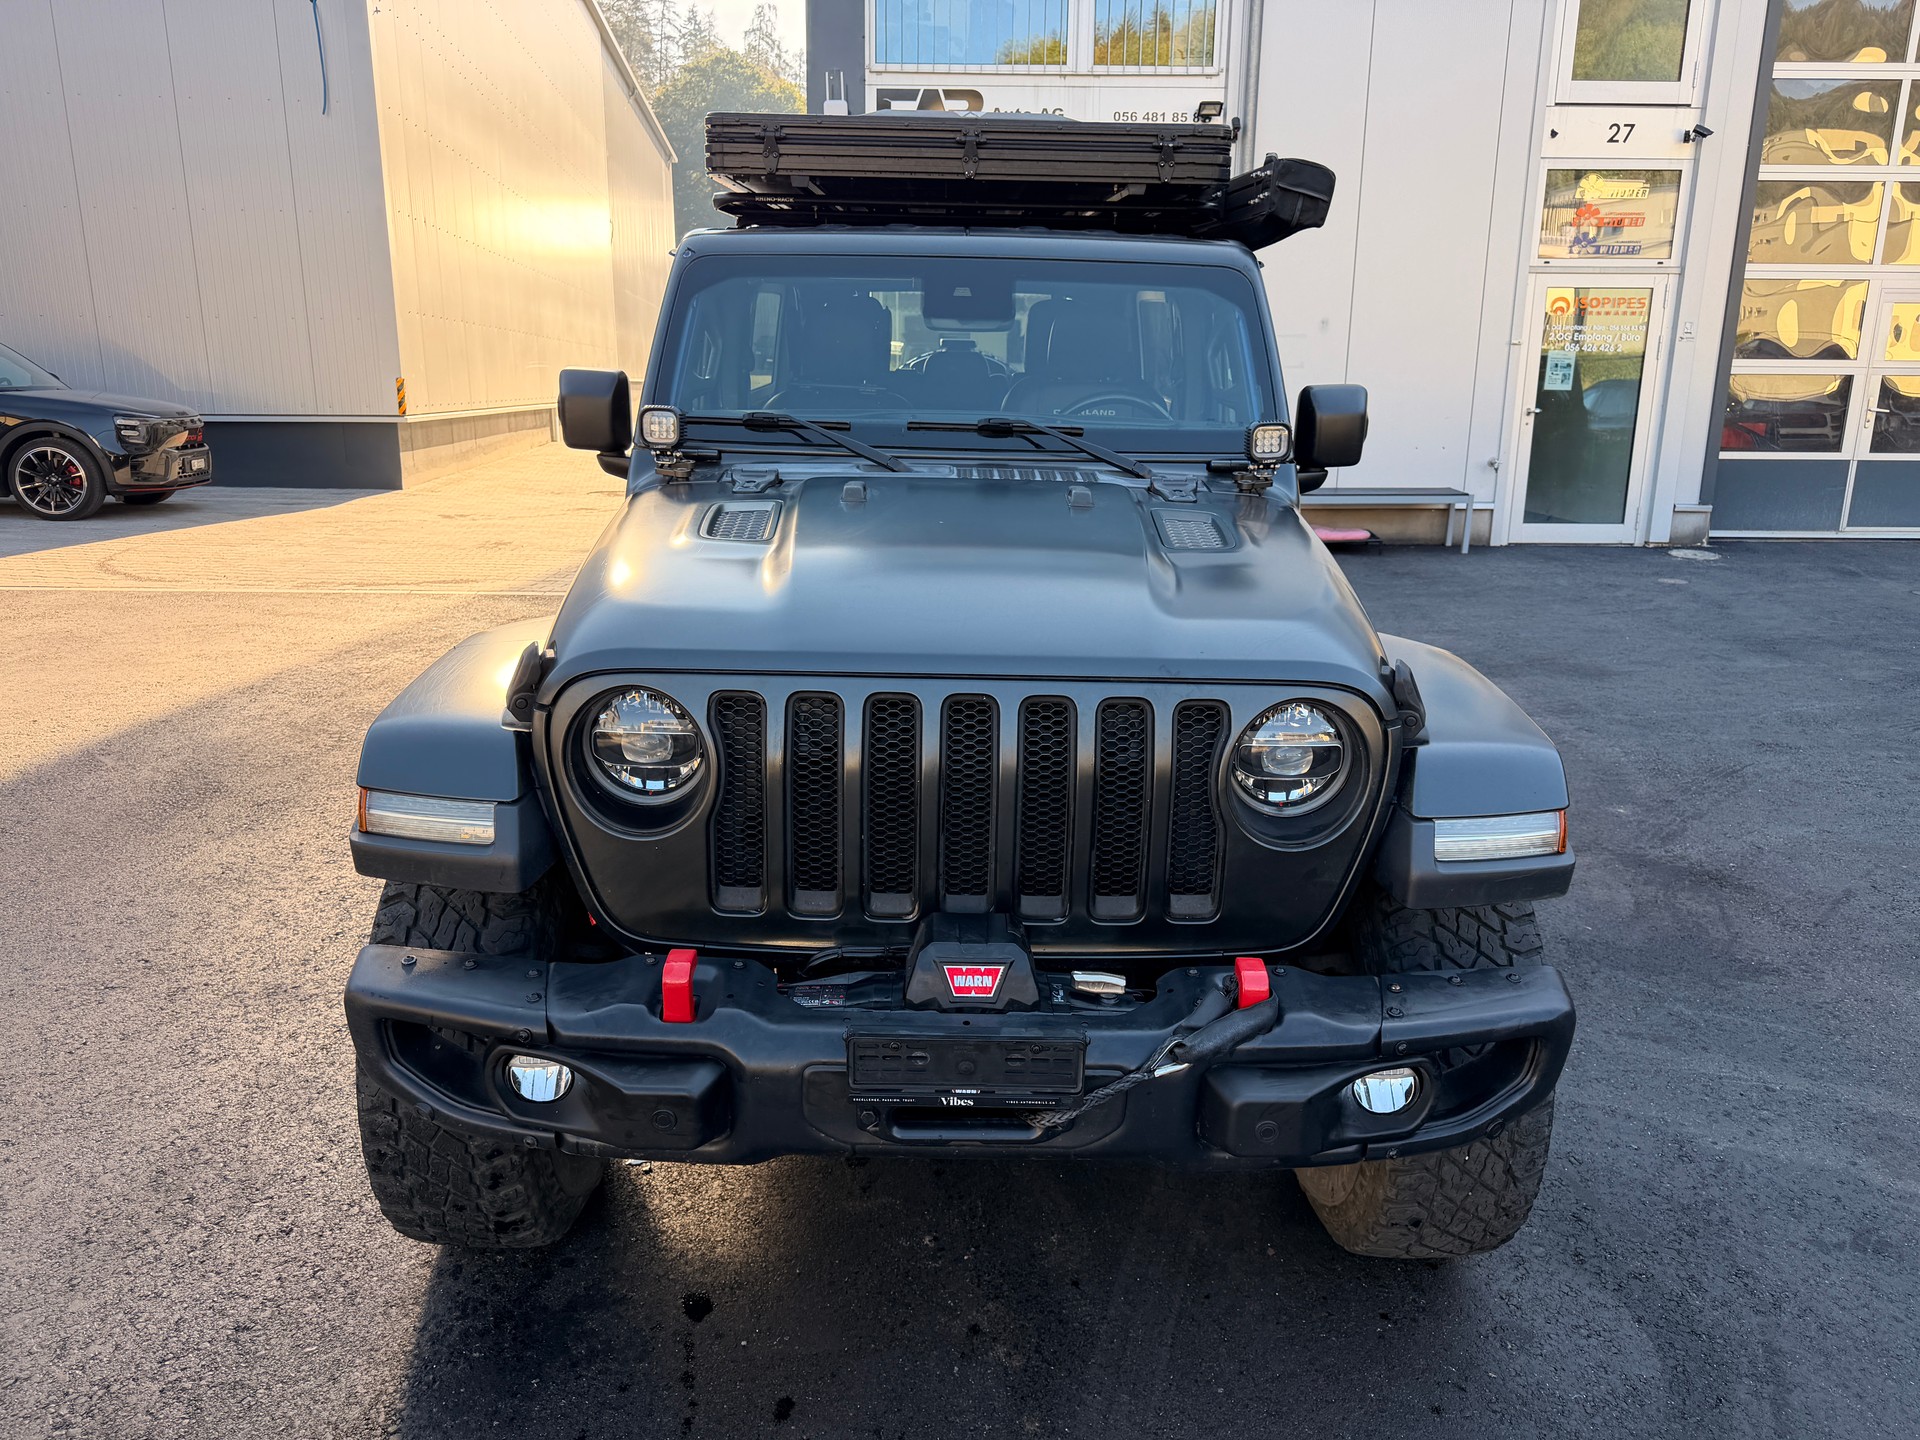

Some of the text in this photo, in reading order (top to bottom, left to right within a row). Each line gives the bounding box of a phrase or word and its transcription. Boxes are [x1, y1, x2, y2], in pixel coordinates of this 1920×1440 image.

[1113, 112, 1138, 121] 056
[1142, 112, 1166, 122] 481
[1171, 112, 1188, 122] 85
[1606, 123, 1636, 143] 27
[1574, 297, 1647, 309] ISOPIPES
[1574, 333, 1612, 343] Empfang
[1621, 333, 1641, 341] Büro
[1600, 344, 1615, 352] 426
[1617, 344, 1623, 352] 2
[953, 975, 993, 987] WARN
[941, 1096, 974, 1106] Vibes
